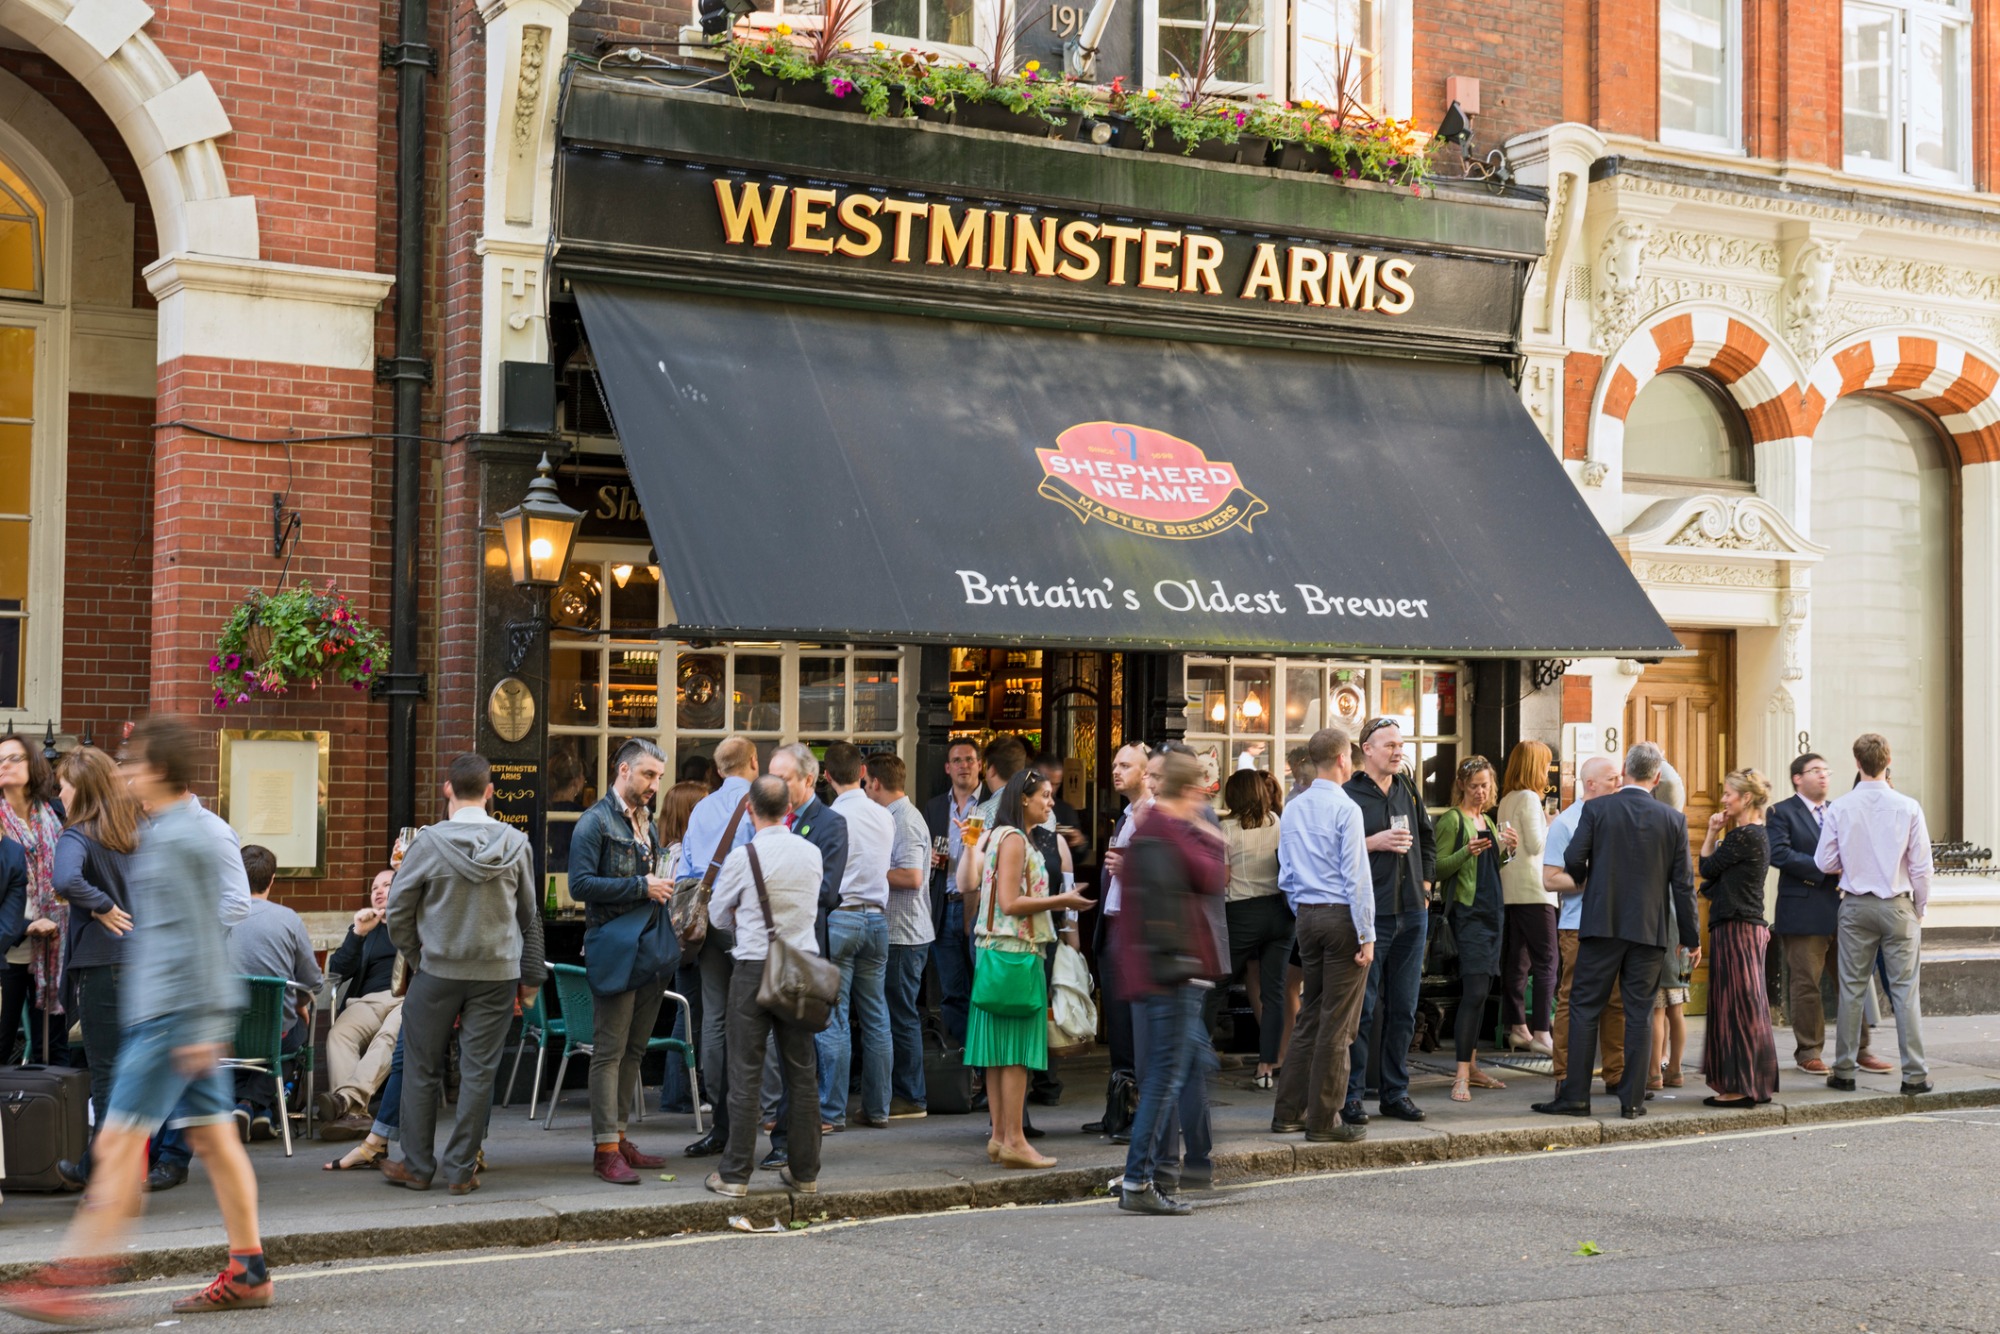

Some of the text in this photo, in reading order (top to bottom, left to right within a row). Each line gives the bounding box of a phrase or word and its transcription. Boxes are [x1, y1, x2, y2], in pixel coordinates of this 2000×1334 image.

[1050, 4, 1083, 37] 191
[713, 179, 1417, 316] WESTMINSTER ARMS
[1049, 455, 1232, 486] SHEPHERD
[595, 485, 645, 521] Sh
[1091, 479, 1210, 504] NEAME
[1077, 496, 1240, 536] MASTER BREWERS
[955, 569, 1429, 618] Britain's Oldest Brewer
[1605, 727, 1617, 753] 8
[1798, 731, 1811, 755] 8
[500, 773, 522, 781] ARMS
[492, 810, 528, 823] Queen
